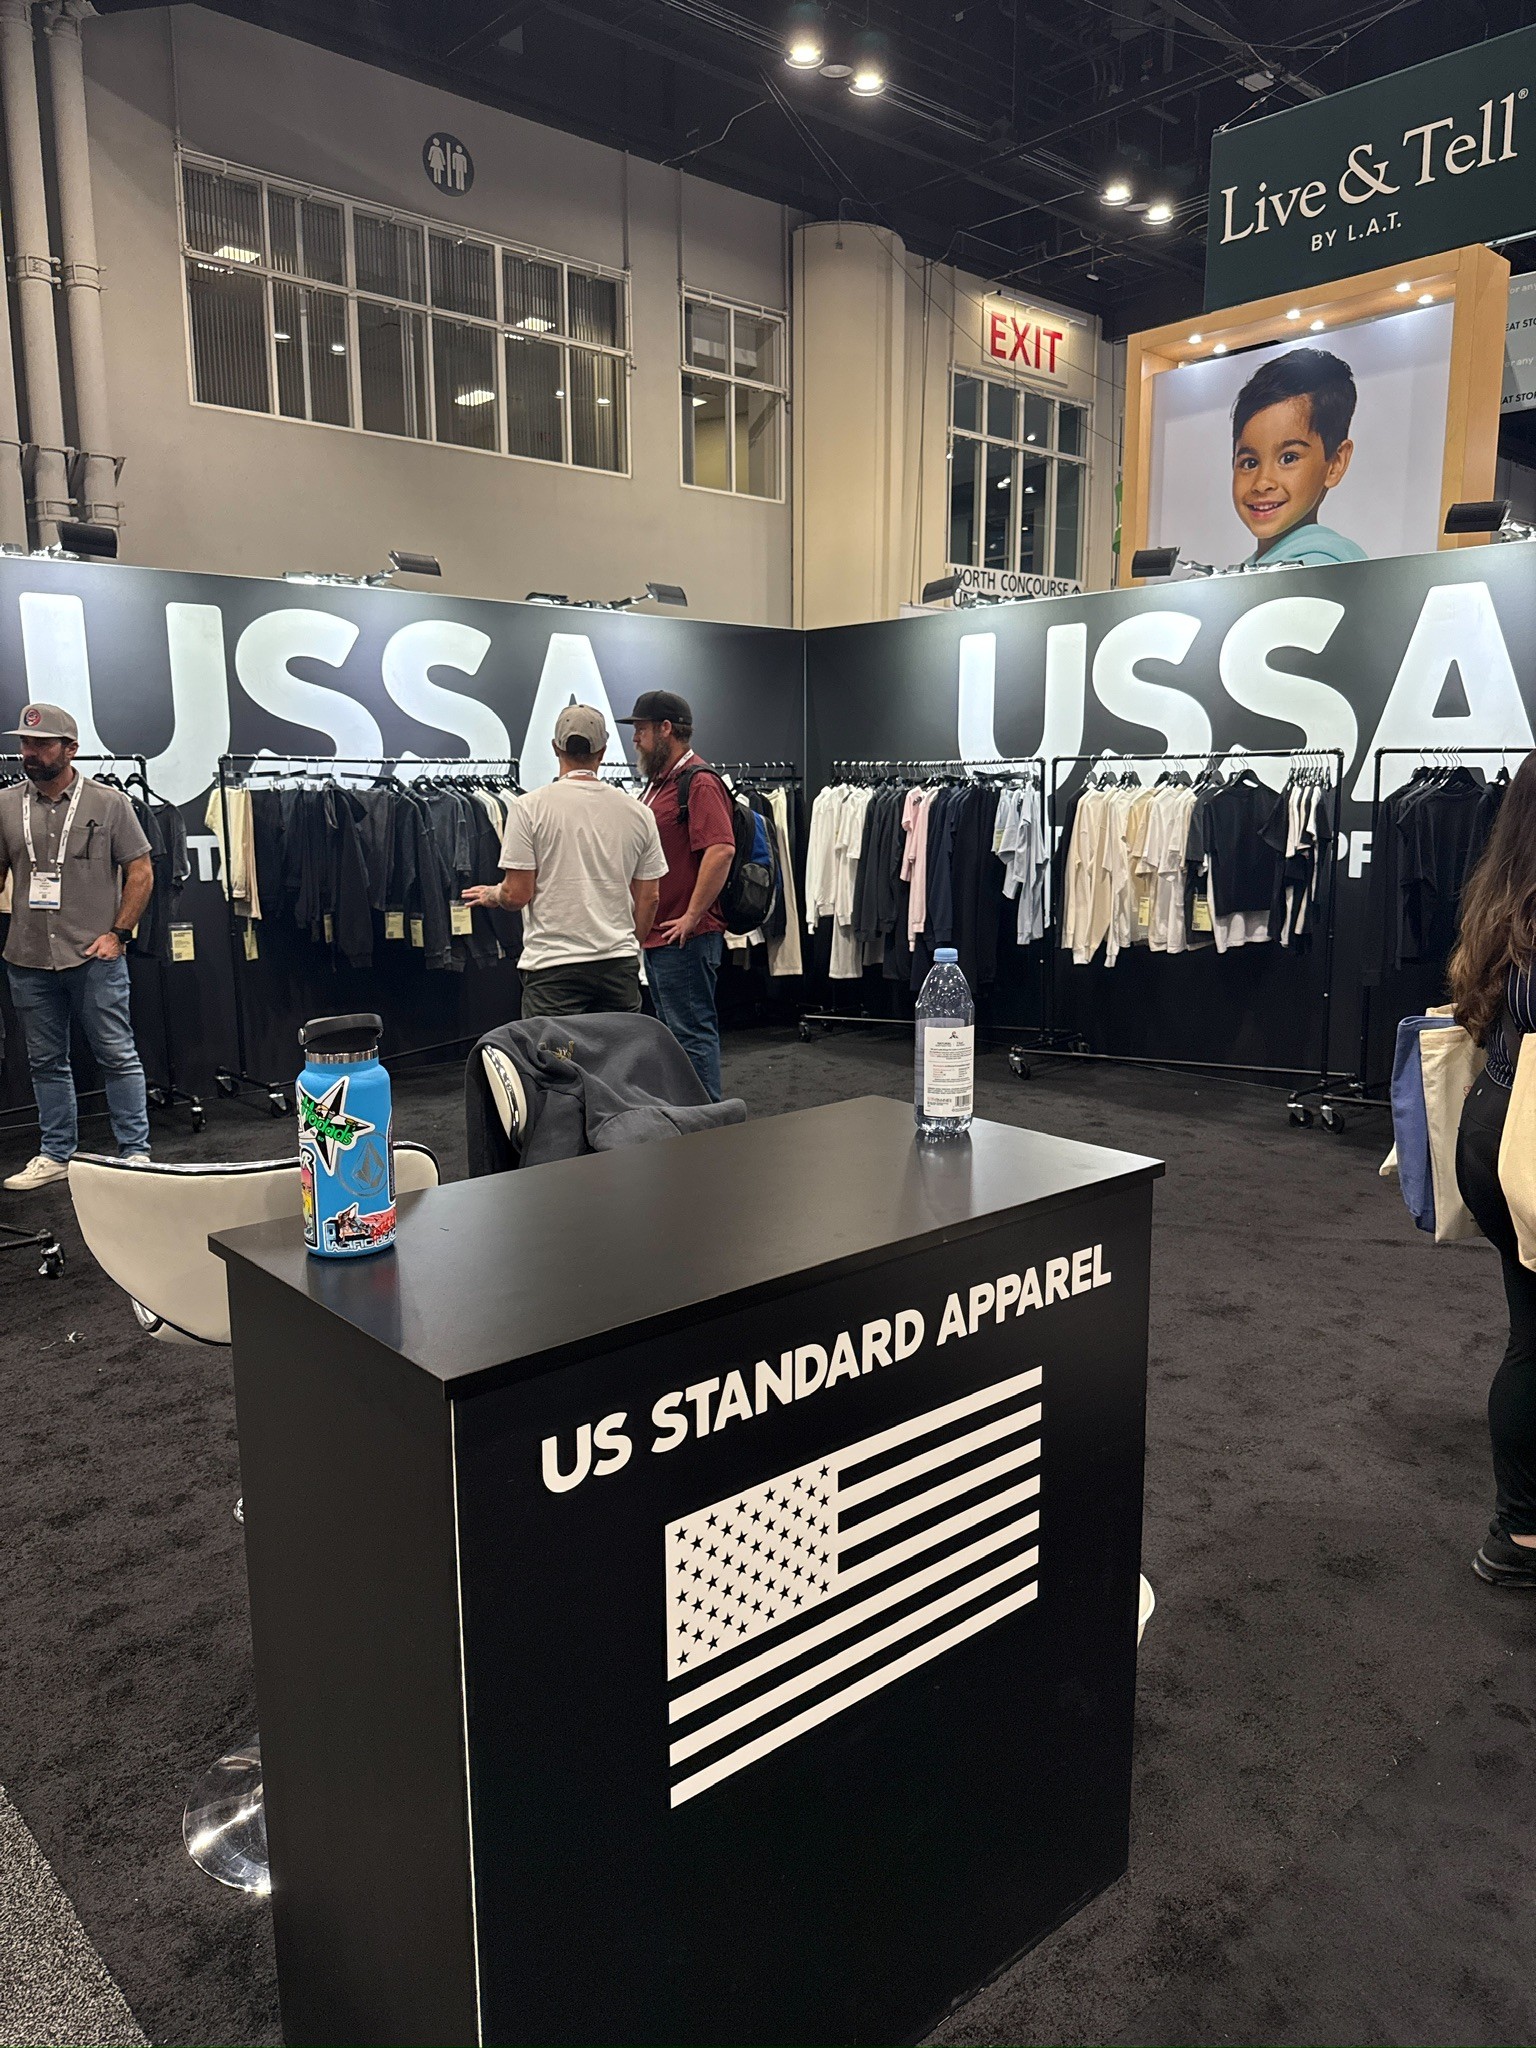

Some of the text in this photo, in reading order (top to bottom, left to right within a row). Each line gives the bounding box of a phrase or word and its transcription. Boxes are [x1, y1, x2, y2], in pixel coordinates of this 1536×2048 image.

[1220, 180, 1327, 244] Live
[1338, 143, 1400, 205] &
[1311, 212, 1402, 251] BY L.A.T.
[990, 311, 1063, 374] EXIT
[1500, 395, 1513, 405] AT
[1001, 573, 1069, 597] CONCOURSE
[19, 591, 638, 808] USSA
[957, 581, 1536, 803] USSA
[376, 1227, 397, 1246] BEAC
[541, 1243, 1112, 1493] US STANDARD APPAREL
